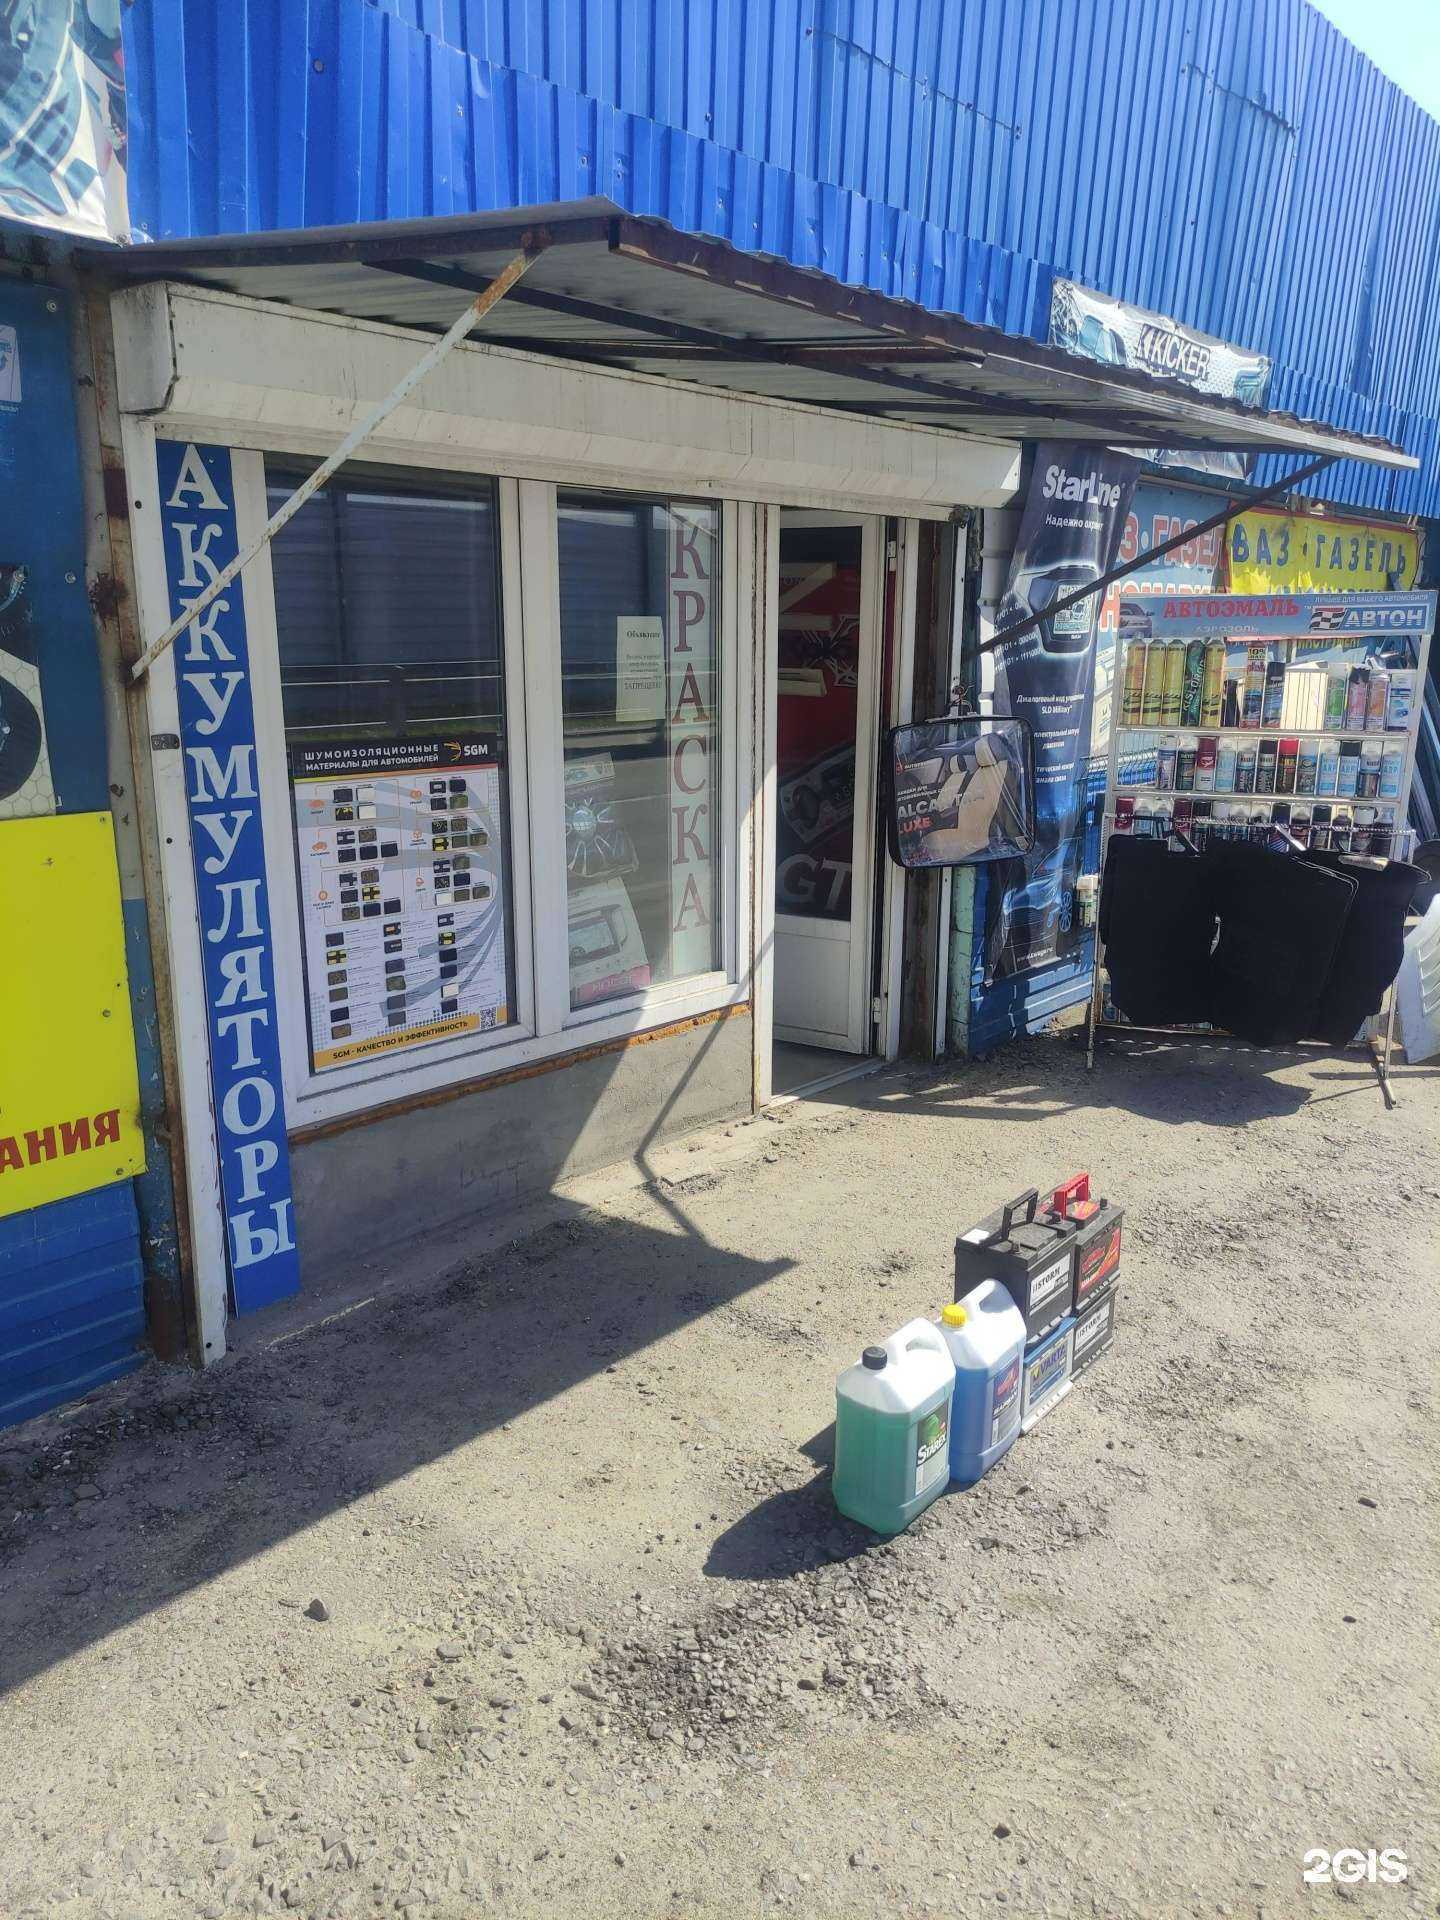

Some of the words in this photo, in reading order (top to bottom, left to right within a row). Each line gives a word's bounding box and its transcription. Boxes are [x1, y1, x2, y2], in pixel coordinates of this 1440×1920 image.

[1043, 465, 1122, 507] StarLine
[1045, 514, 1084, 528] Надежно
[1232, 522, 1290, 567] ВАЗ
[1314, 533, 1406, 575] ГАЗЕЛЬ
[1163, 598, 1301, 619] АВТОЭМАЛЬ
[1344, 608, 1424, 628] АВТОН
[671, 521, 713, 933] КРАСКА
[304, 744, 439, 761] ШУМОИЗОЛЯЦИОННЫЕ
[305, 761, 360, 772] МАТЕРИАЛЫ
[361, 759, 379, 768] ДЛЯ
[380, 754, 439, 766] АВТОМОБИЛЕЙ
[463, 744, 488, 756] SGM
[165, 443, 297, 1270] АККУМУЛЯТОРЫ
[356, 1038, 397, 1053] КАЧЕСТВО
[405, 1020, 468, 1041] ЭФФЕКТИВНОСТЬ
[0, 1109, 120, 1174] АНИЯ
